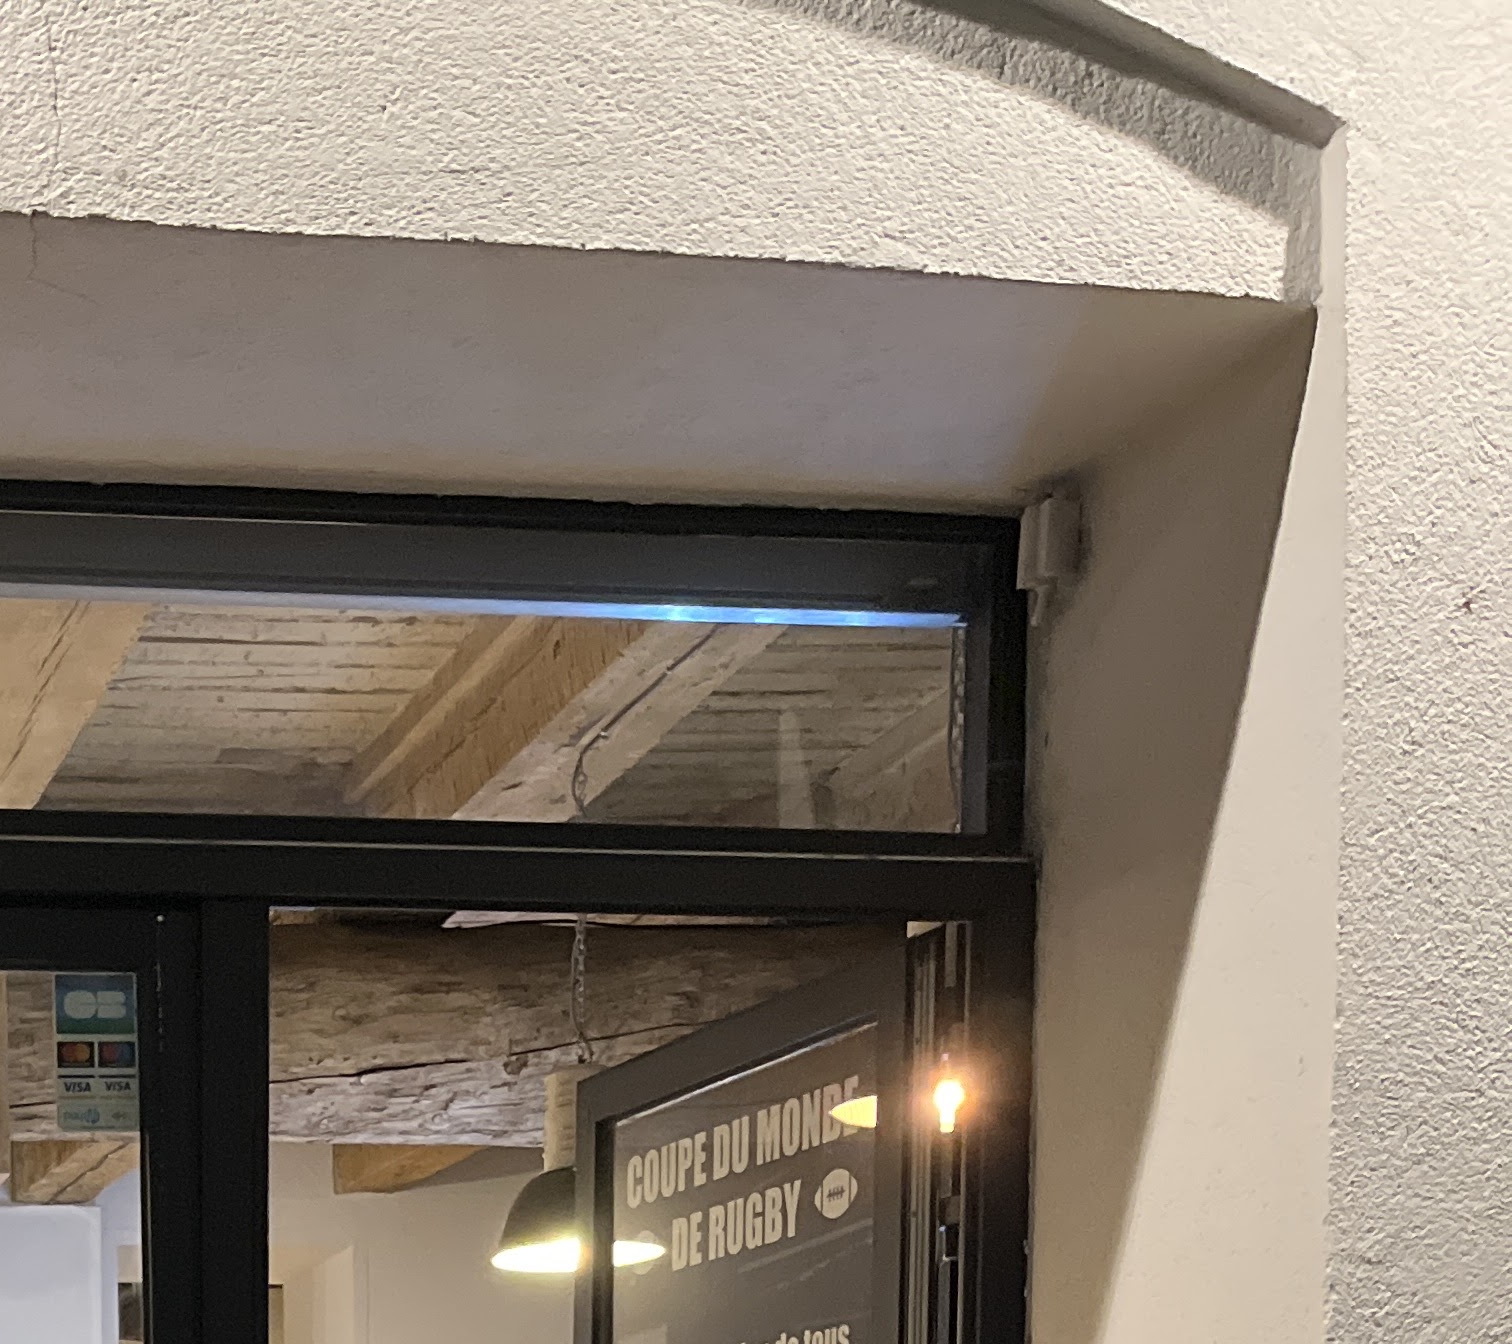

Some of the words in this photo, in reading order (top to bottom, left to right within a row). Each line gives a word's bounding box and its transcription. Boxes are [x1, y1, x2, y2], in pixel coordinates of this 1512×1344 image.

[64, 1082, 92, 1093] VISA
[104, 1081, 131, 1092] VISA
[626, 1131, 707, 1209] COUPE
[712, 1115, 750, 1181] DU
[671, 1211, 703, 1272] DE
[708, 1179, 802, 1261] RUGBY
